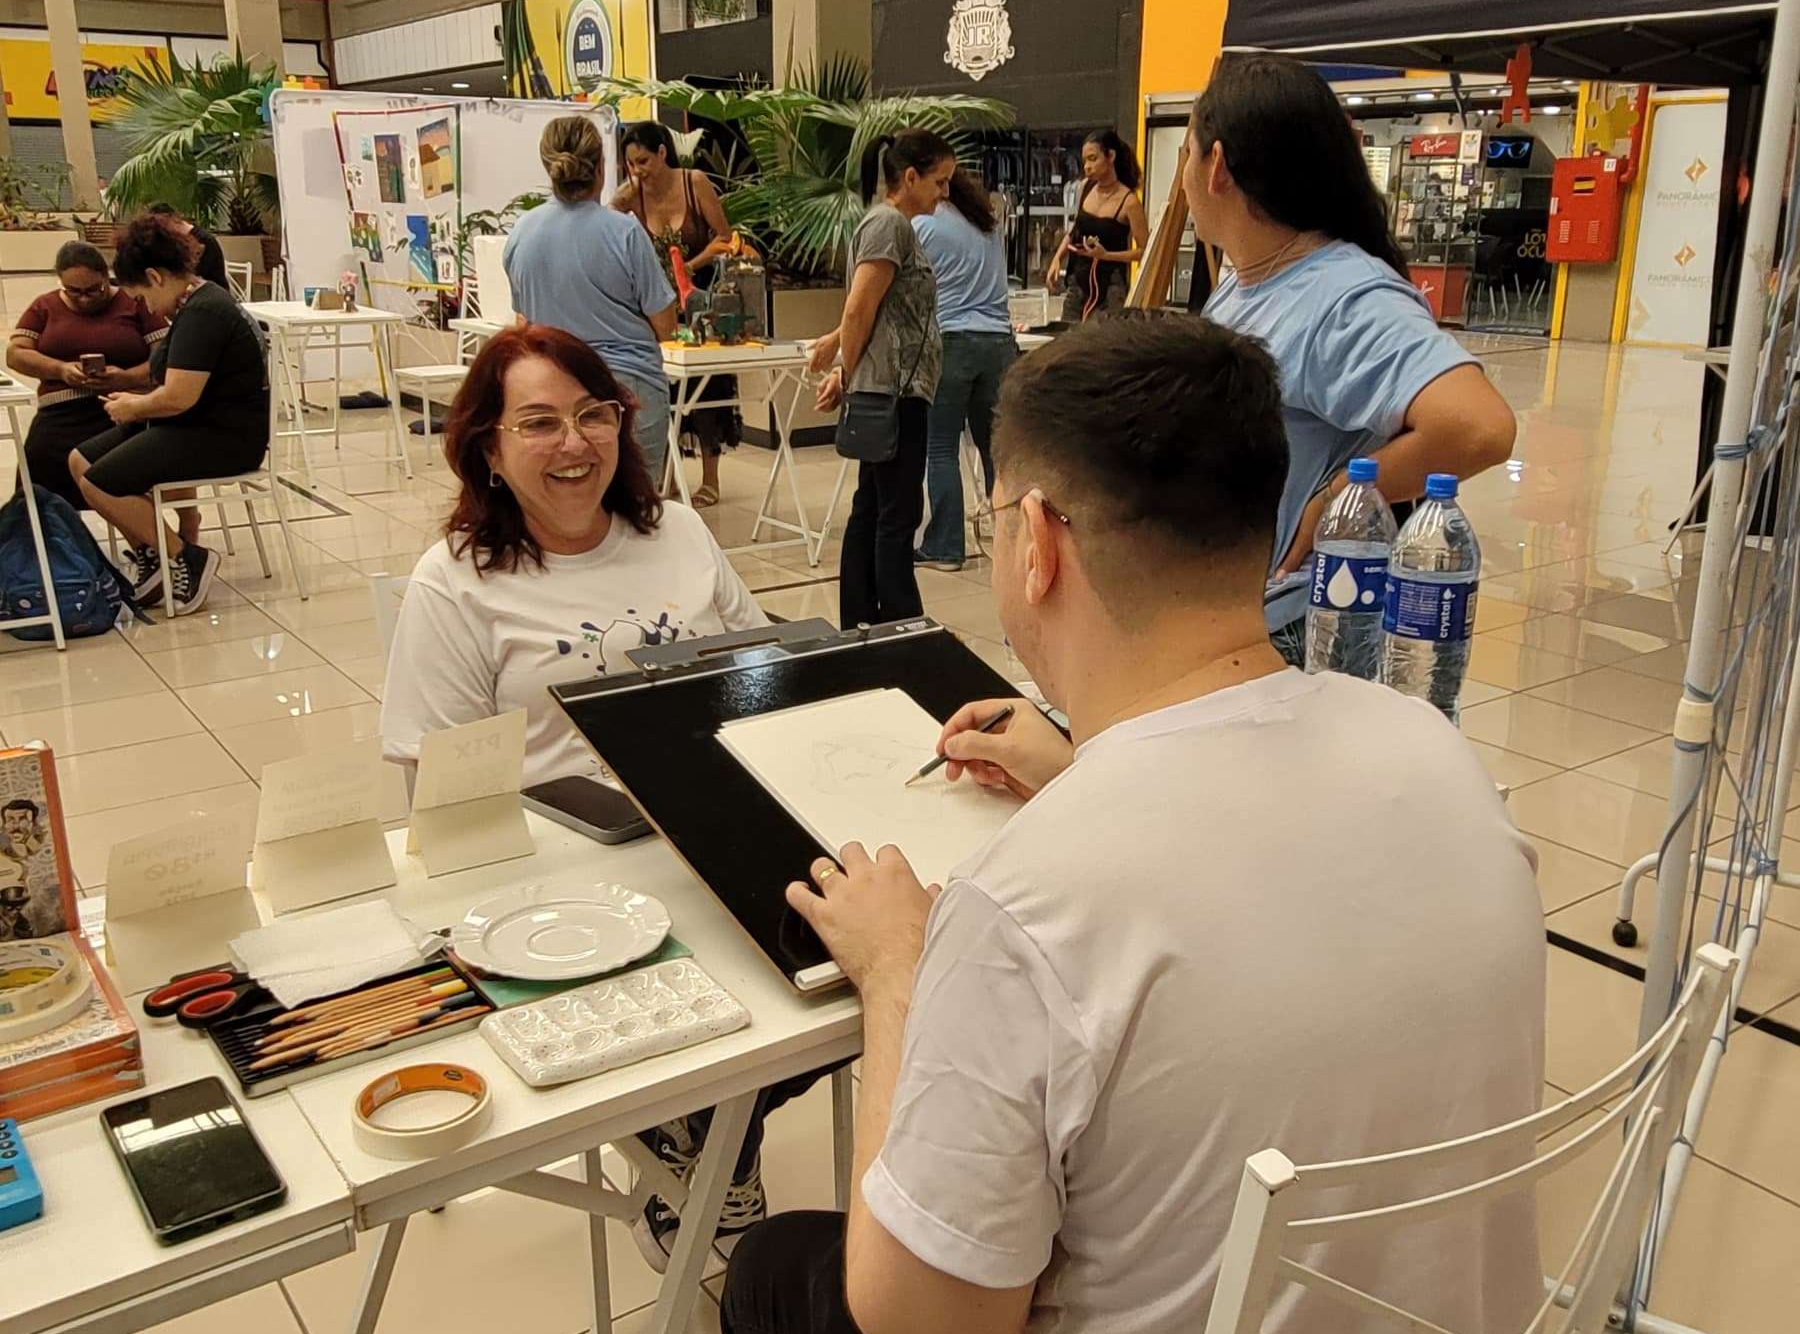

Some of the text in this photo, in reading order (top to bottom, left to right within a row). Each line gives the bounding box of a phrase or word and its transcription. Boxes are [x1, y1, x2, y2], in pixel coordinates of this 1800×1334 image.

[578, 33, 596, 51] BEM
[963, 25, 992, 46] JR
[576, 59, 602, 77] BRASIL
[1312, 553, 1327, 603] crystal
[1440, 601, 1452, 639] crystal
